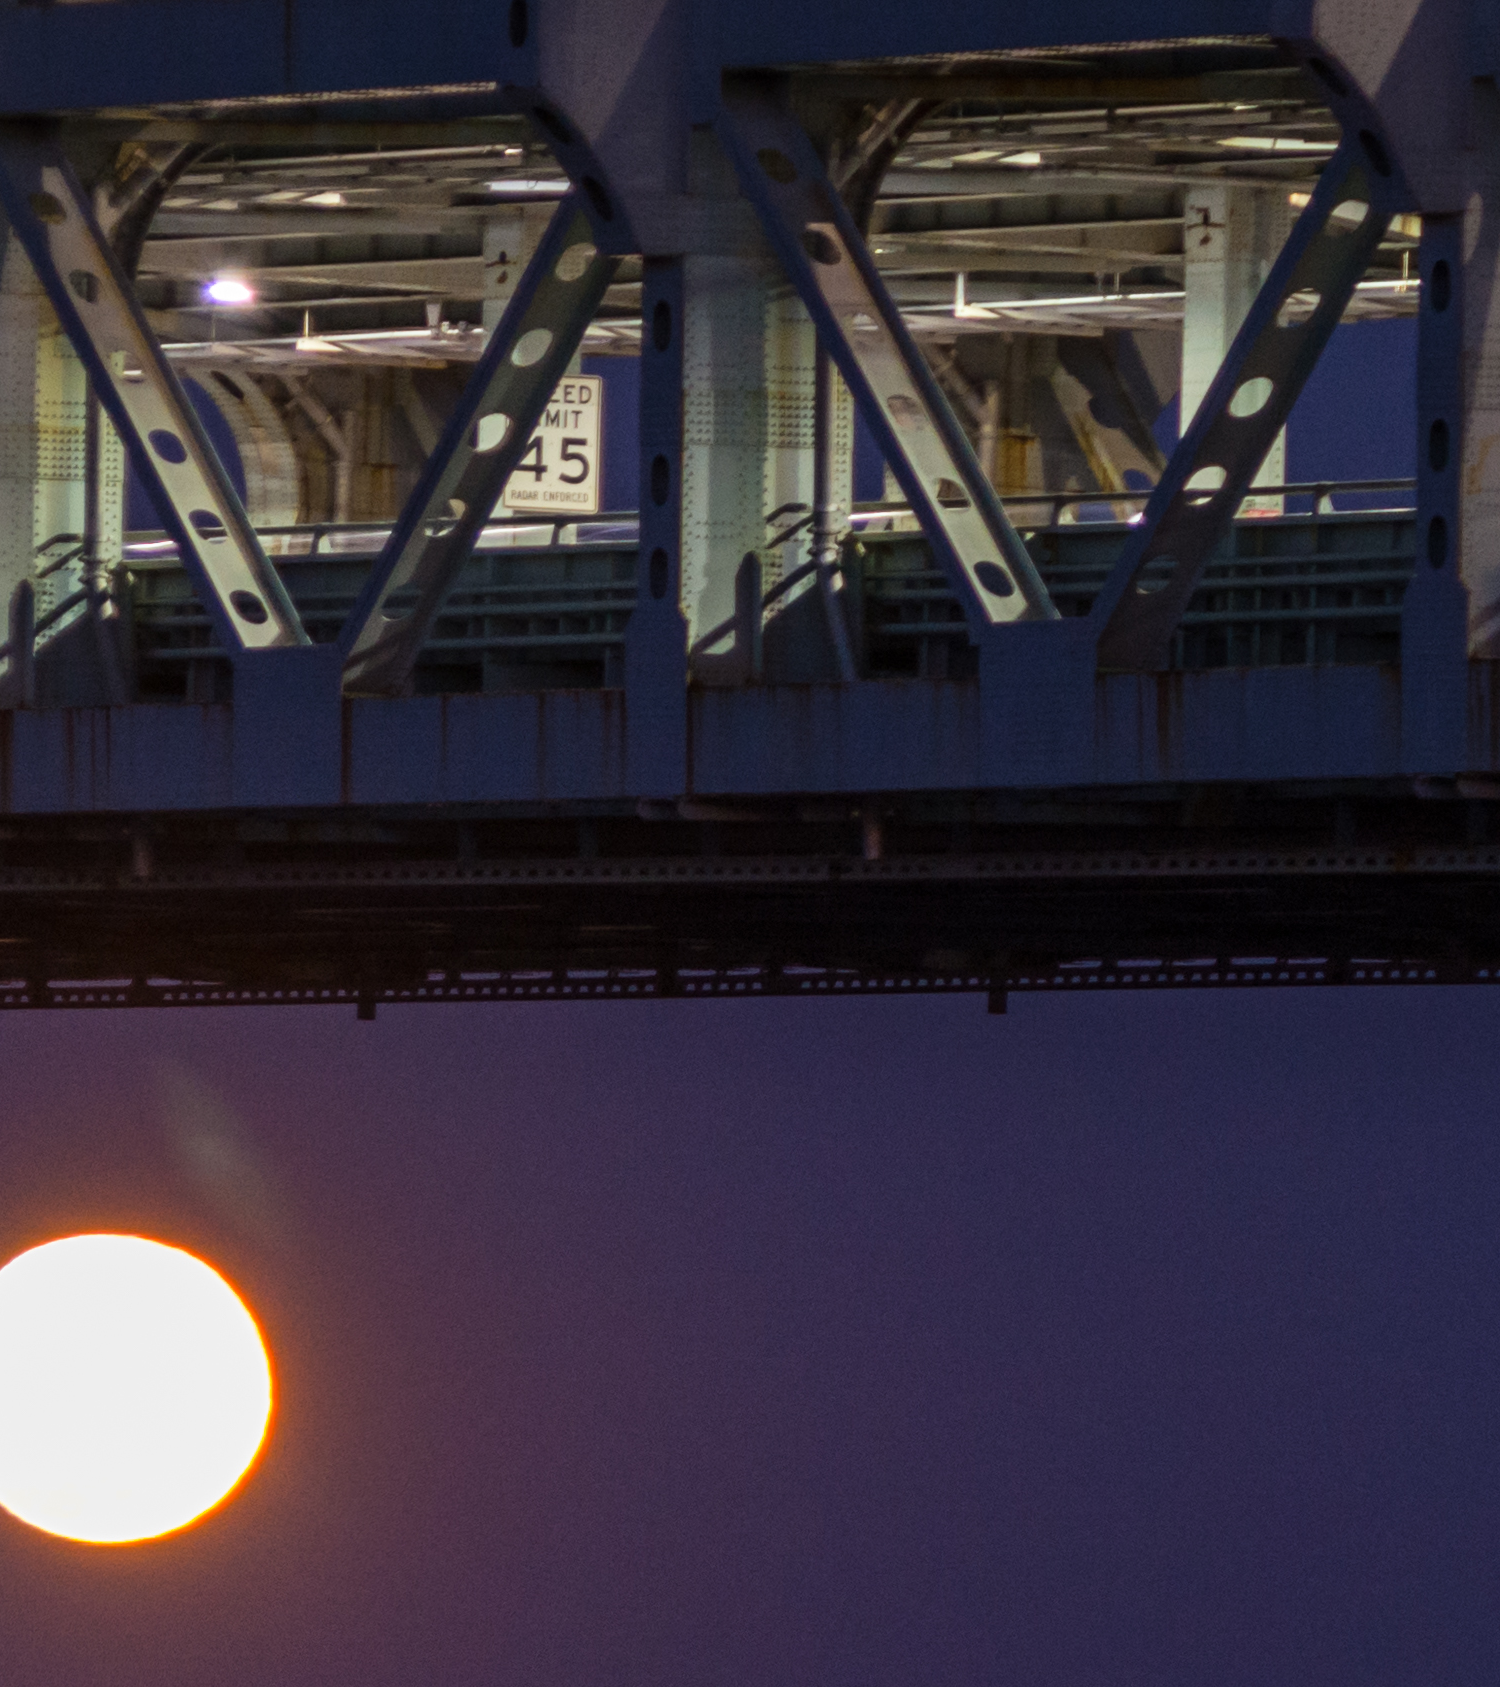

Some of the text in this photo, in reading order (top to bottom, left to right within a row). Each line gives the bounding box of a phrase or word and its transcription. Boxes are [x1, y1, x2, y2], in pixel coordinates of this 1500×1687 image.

[514, 435, 590, 484] 45
[511, 489, 589, 503] RADAR ENFORCED
